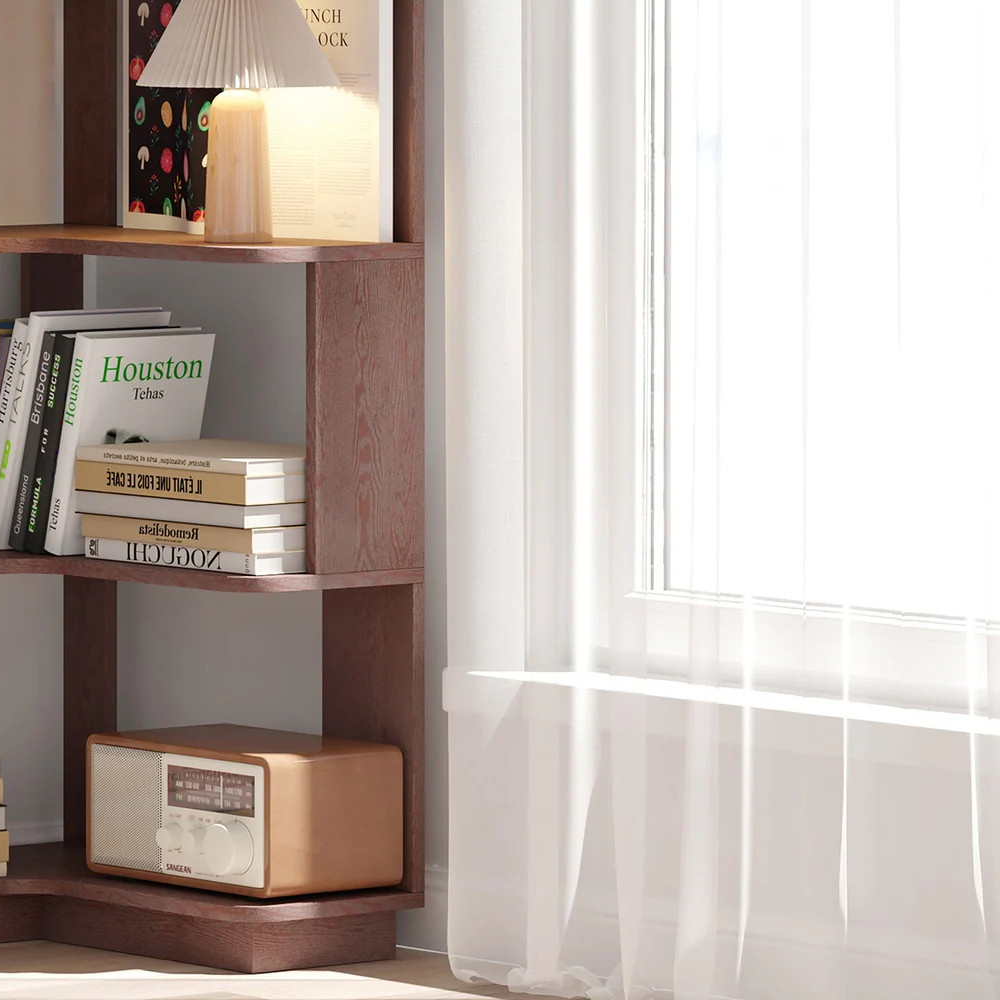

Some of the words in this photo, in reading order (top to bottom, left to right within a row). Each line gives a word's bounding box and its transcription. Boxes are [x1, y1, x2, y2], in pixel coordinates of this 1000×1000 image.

[30, 351, 51, 425] Brisbane
[47, 354, 61, 408] SUCCESS
[99, 355, 203, 383] Houston
[64, 358, 83, 426] Houston
[133, 387, 164, 401] Tehas
[41, 428, 49, 454] FOR
[14, 474, 29, 535] Queensland
[28, 477, 42, 533] FORMULA
[48, 498, 61, 531] Tehas
[166, 863, 192, 874] SANGEAN
